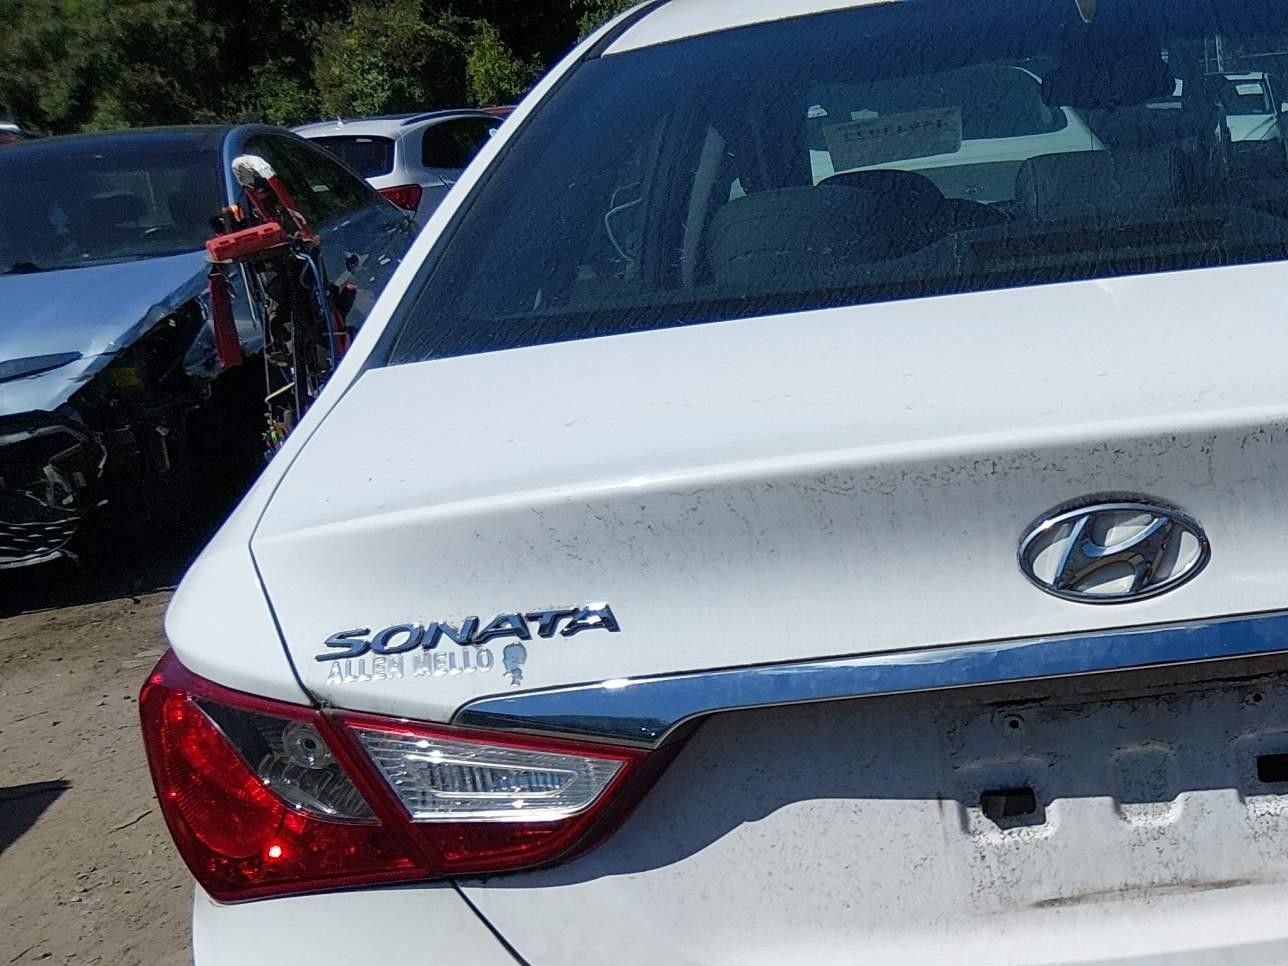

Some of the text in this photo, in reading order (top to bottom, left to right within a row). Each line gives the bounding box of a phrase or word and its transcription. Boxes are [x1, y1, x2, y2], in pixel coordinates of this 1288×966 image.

[315, 601, 621, 661] SONATA
[327, 647, 495, 685] ALLEN MELLO
